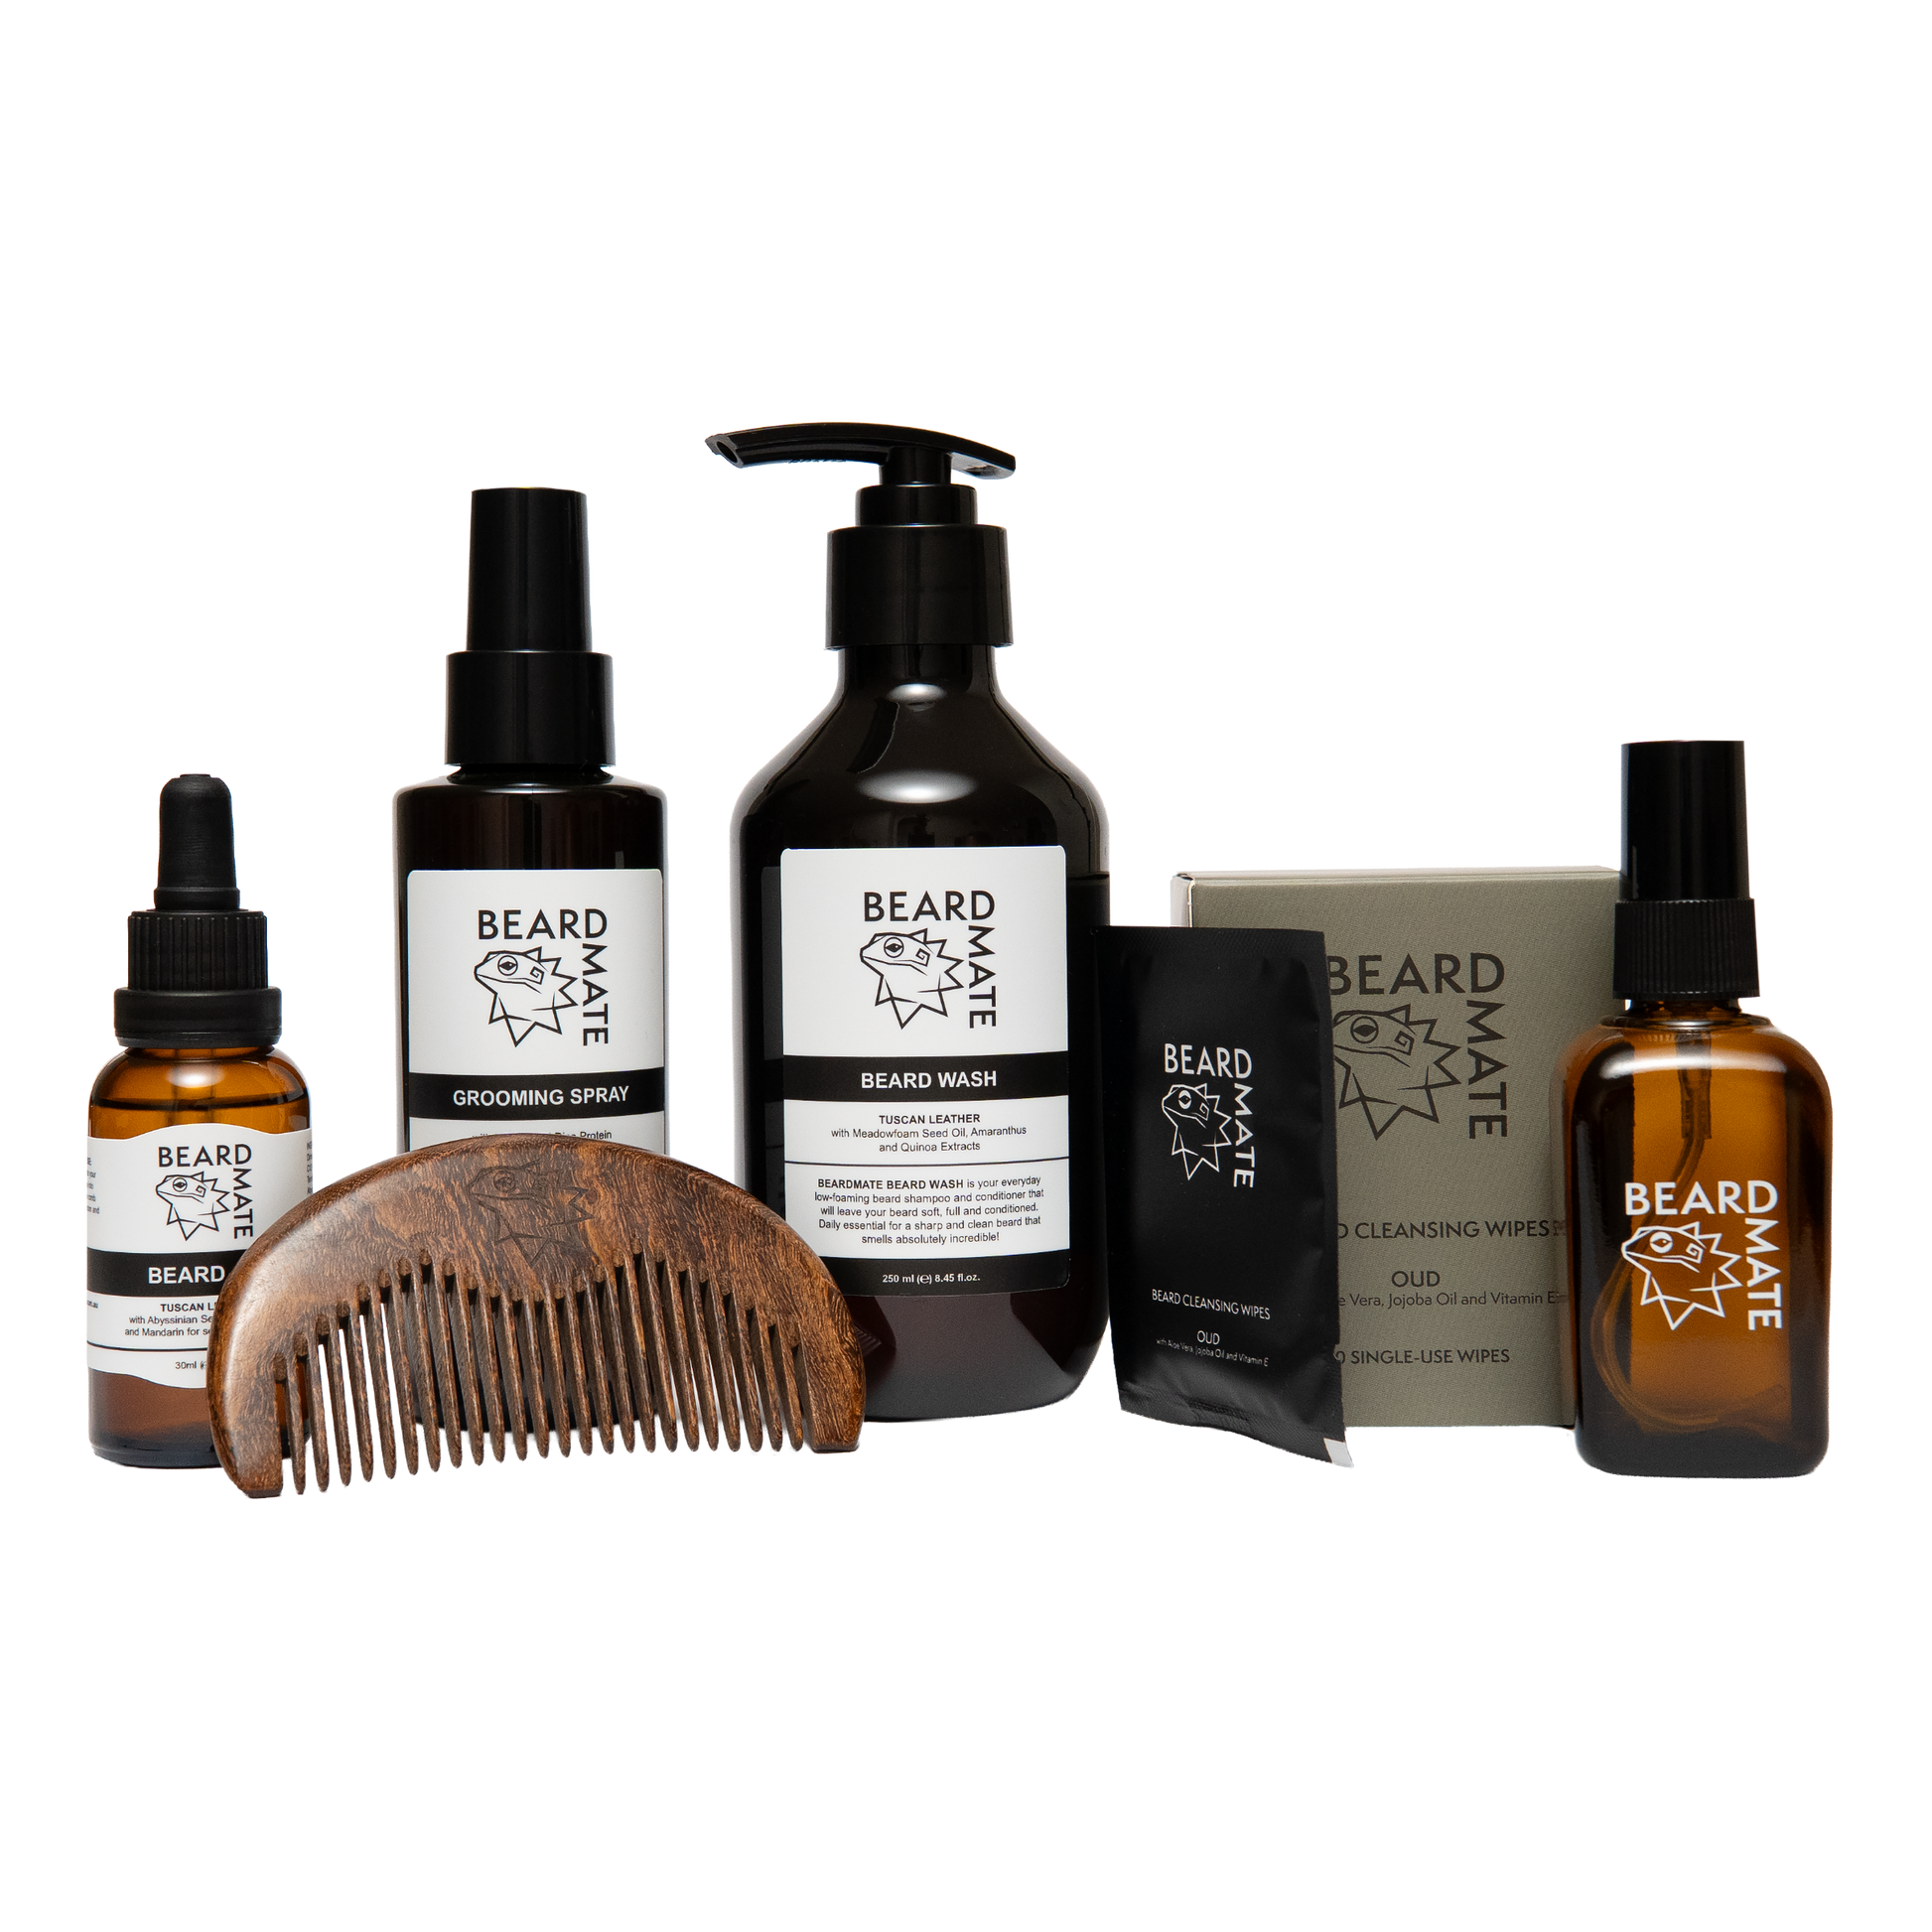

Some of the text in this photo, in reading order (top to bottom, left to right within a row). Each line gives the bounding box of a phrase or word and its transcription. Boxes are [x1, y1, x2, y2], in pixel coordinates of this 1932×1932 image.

[864, 890, 995, 921] BEARD
[478, 908, 608, 939] BEARD
[968, 924, 996, 1029] MATE
[1327, 953, 1505, 995] BEARD
[582, 943, 609, 1046] MATE
[1164, 1043, 1253, 1079] BEARD
[1466, 1000, 1509, 1140] MATE
[861, 1070, 997, 1089] BEARD WASH
[453, 1085, 629, 1106] GROOMING SPRAY
[879, 1114, 981, 1125] TUSCAN LEATHER
[831, 1126, 1028, 1139] with Meadowfoam Seed Oil, Amaranthus
[1233, 1082, 1256, 1188] MATE
[158, 1144, 252, 1168] BEARD
[880, 1141, 981, 1152] and Quinoa Extracts
[817, 1175, 1041, 1189] BEARDMATE BEARD WASH is your everyday
[232, 1168, 254, 1239] MATE
[814, 1188, 1044, 1204] low-foaming beard shampoo and conditioner that
[1625, 1180, 1778, 1216] BEARD
[821, 1202, 1038, 1218] will leave your beard soft, full and conditioned.
[818, 1218, 841, 1230] Daily
[843, 1220, 887, 1230] essential
[889, 1220, 902, 1230] for
[914, 1221, 943, 1232] sharp
[946, 1220, 965, 1229] and
[968, 1219, 994, 1229] clean
[996, 1217, 1023, 1228] beard
[1025, 1215, 1041, 1224] that
[1354, 1221, 1480, 1239] CLEANSING
[1485, 1219, 1550, 1238] WIPES
[862, 1231, 1000, 1245] smells absolutely incredible!
[148, 1265, 225, 1284] BEARD
[882, 1274, 899, 1284] 250
[901, 1274, 914, 1284] ml
[934, 1273, 955, 1283] 8.45
[1391, 1270, 1441, 1288] OUD
[1744, 1217, 1782, 1330] MATE
[161, 1303, 205, 1312] TUSCAN
[1152, 1289, 1271, 1320] BEARD CLEANSING WIPES
[1349, 1293, 1385, 1308] Vera,
[1388, 1292, 1433, 1310] Jojoba
[1436, 1291, 1457, 1306] Oil
[1460, 1291, 1487, 1306] and
[1490, 1291, 1543, 1305] Vitamin
[1547, 1291, 1556, 1304] E
[129, 1315, 146, 1324] with
[147, 1315, 199, 1326] Abyssinian
[142, 1328, 185, 1337] Mandarin
[187, 1327, 201, 1336] for
[1196, 1330, 1220, 1345] OUD
[175, 1361, 198, 1370] 30ml
[1215, 1348, 1225, 1359] Oil
[1225, 1352, 1238, 1361] and
[1238, 1353, 1263, 1365] Vitamin
[1351, 1349, 1453, 1364] SINGLE-USE
[1457, 1348, 1511, 1363] WIPES
